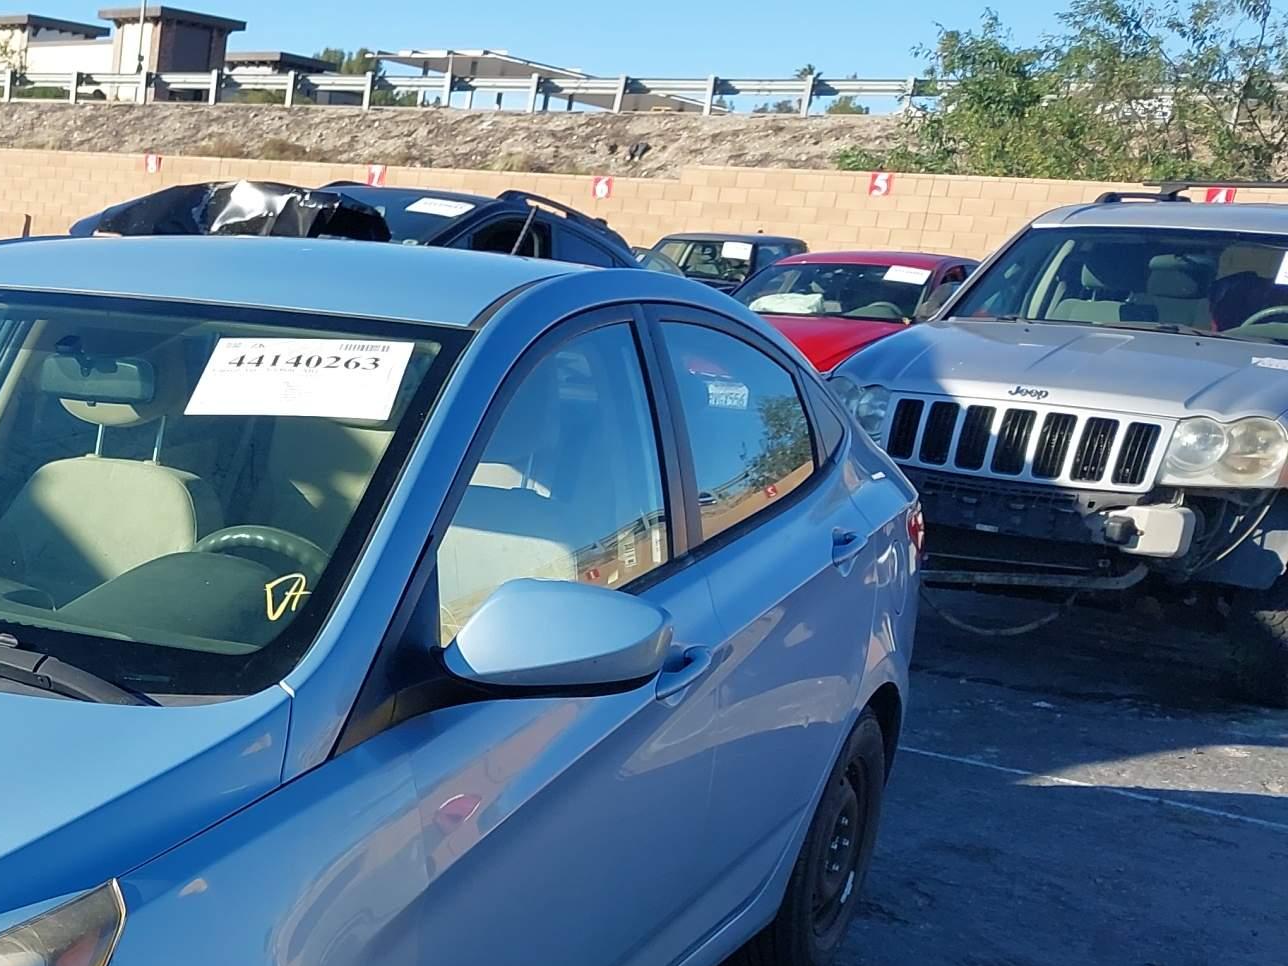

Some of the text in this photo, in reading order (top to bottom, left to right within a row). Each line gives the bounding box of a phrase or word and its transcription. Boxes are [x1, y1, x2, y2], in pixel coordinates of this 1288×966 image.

[595, 175, 609, 199] 6
[871, 172, 888, 197] 5
[228, 353, 381, 371] 44140263
[1008, 385, 1049, 400] Jeep
